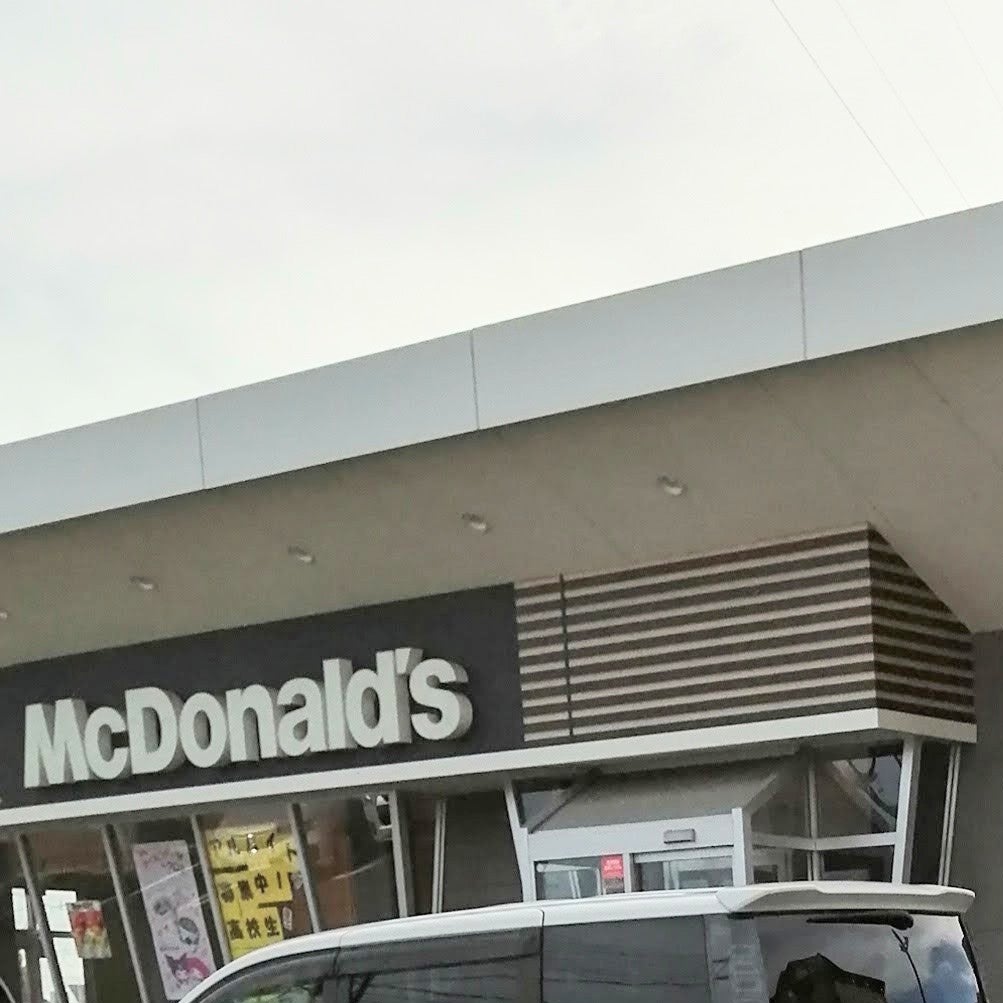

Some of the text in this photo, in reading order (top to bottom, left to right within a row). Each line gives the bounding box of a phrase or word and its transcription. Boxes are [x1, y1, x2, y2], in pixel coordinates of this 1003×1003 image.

[24, 647, 471, 788] McDonald's
[226, 915, 281, 940] 高校生
